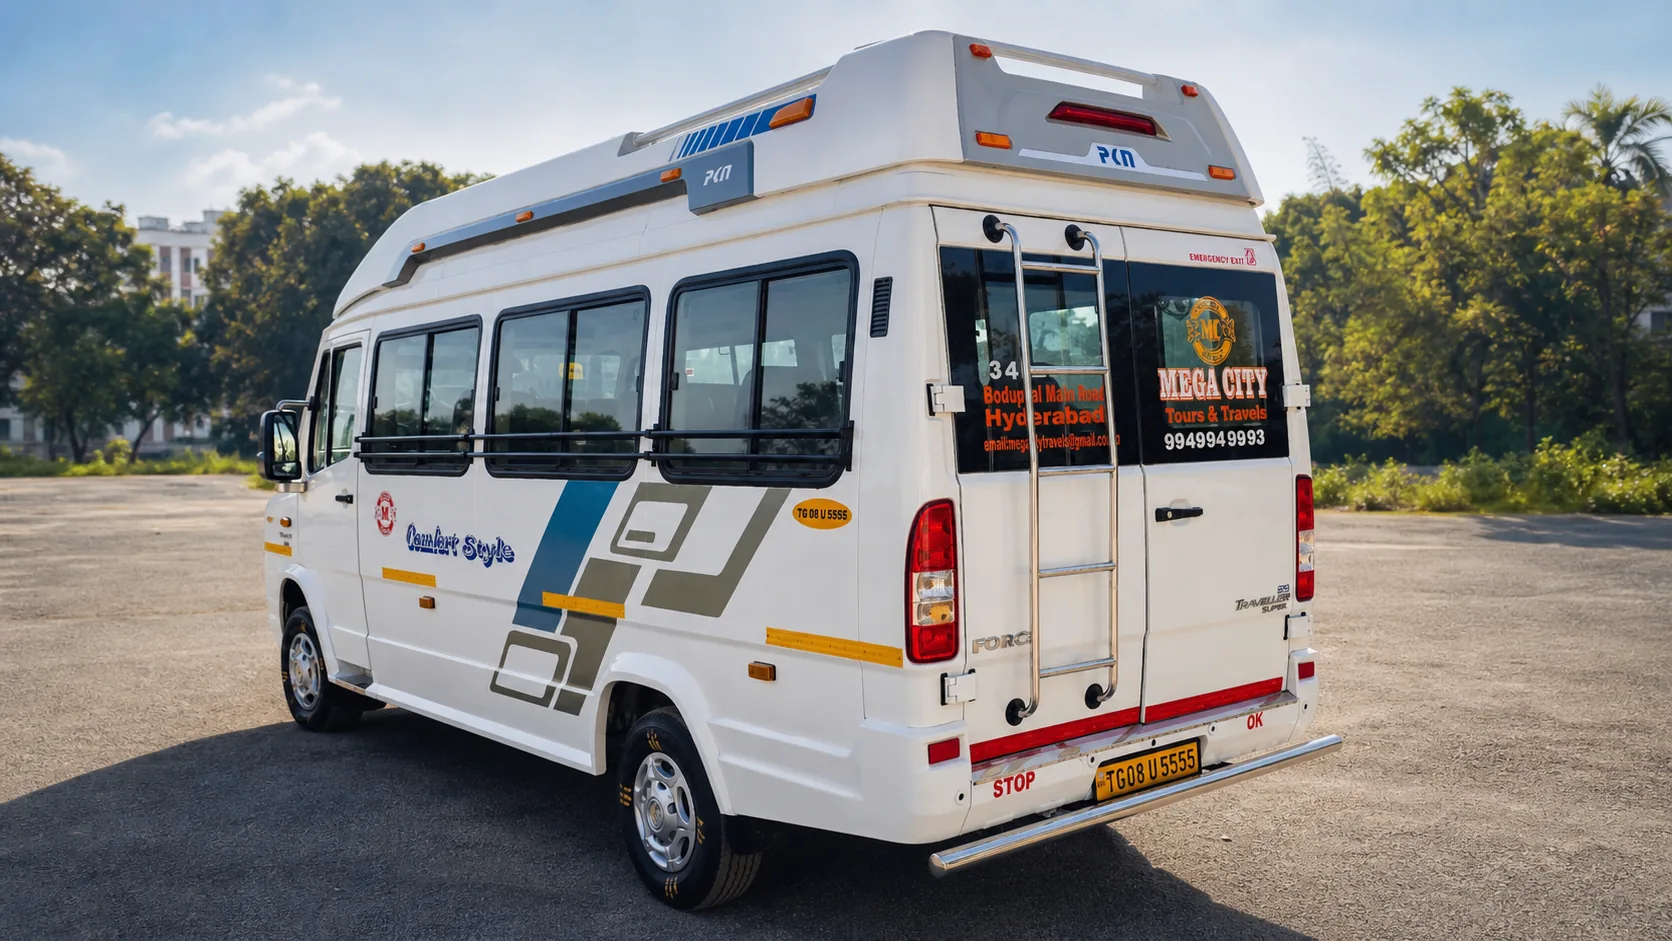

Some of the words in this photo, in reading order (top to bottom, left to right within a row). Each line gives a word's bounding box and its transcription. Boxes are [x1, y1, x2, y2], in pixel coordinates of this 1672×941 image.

[1189, 252, 1229, 264] EMERGENCY
[1230, 257, 1244, 265] EXIT
[989, 360, 1019, 380] 34
[1157, 367, 1222, 402] MEGA
[1222, 366, 1268, 400] CITY
[983, 384, 1042, 408] Bodupal
[1045, 384, 1075, 403] Main
[1077, 384, 1104, 402] Road
[985, 404, 1105, 432] Hyderabad
[1165, 407, 1205, 424] Tours
[1207, 405, 1218, 422] &
[1220, 404, 1267, 421] Travels
[1164, 429, 1266, 451] 9949949993
[797, 507, 808, 519] TG
[809, 508, 819, 519] 08
[820, 509, 827, 520] U
[827, 509, 848, 521] 5555
[972, 630, 1033, 654] FORC
[1247, 711, 1264, 730] OK
[1106, 762, 1145, 793] TG08
[1148, 758, 1158, 780] U
[1160, 748, 1195, 777] 5555
[993, 771, 1036, 798] STOP
